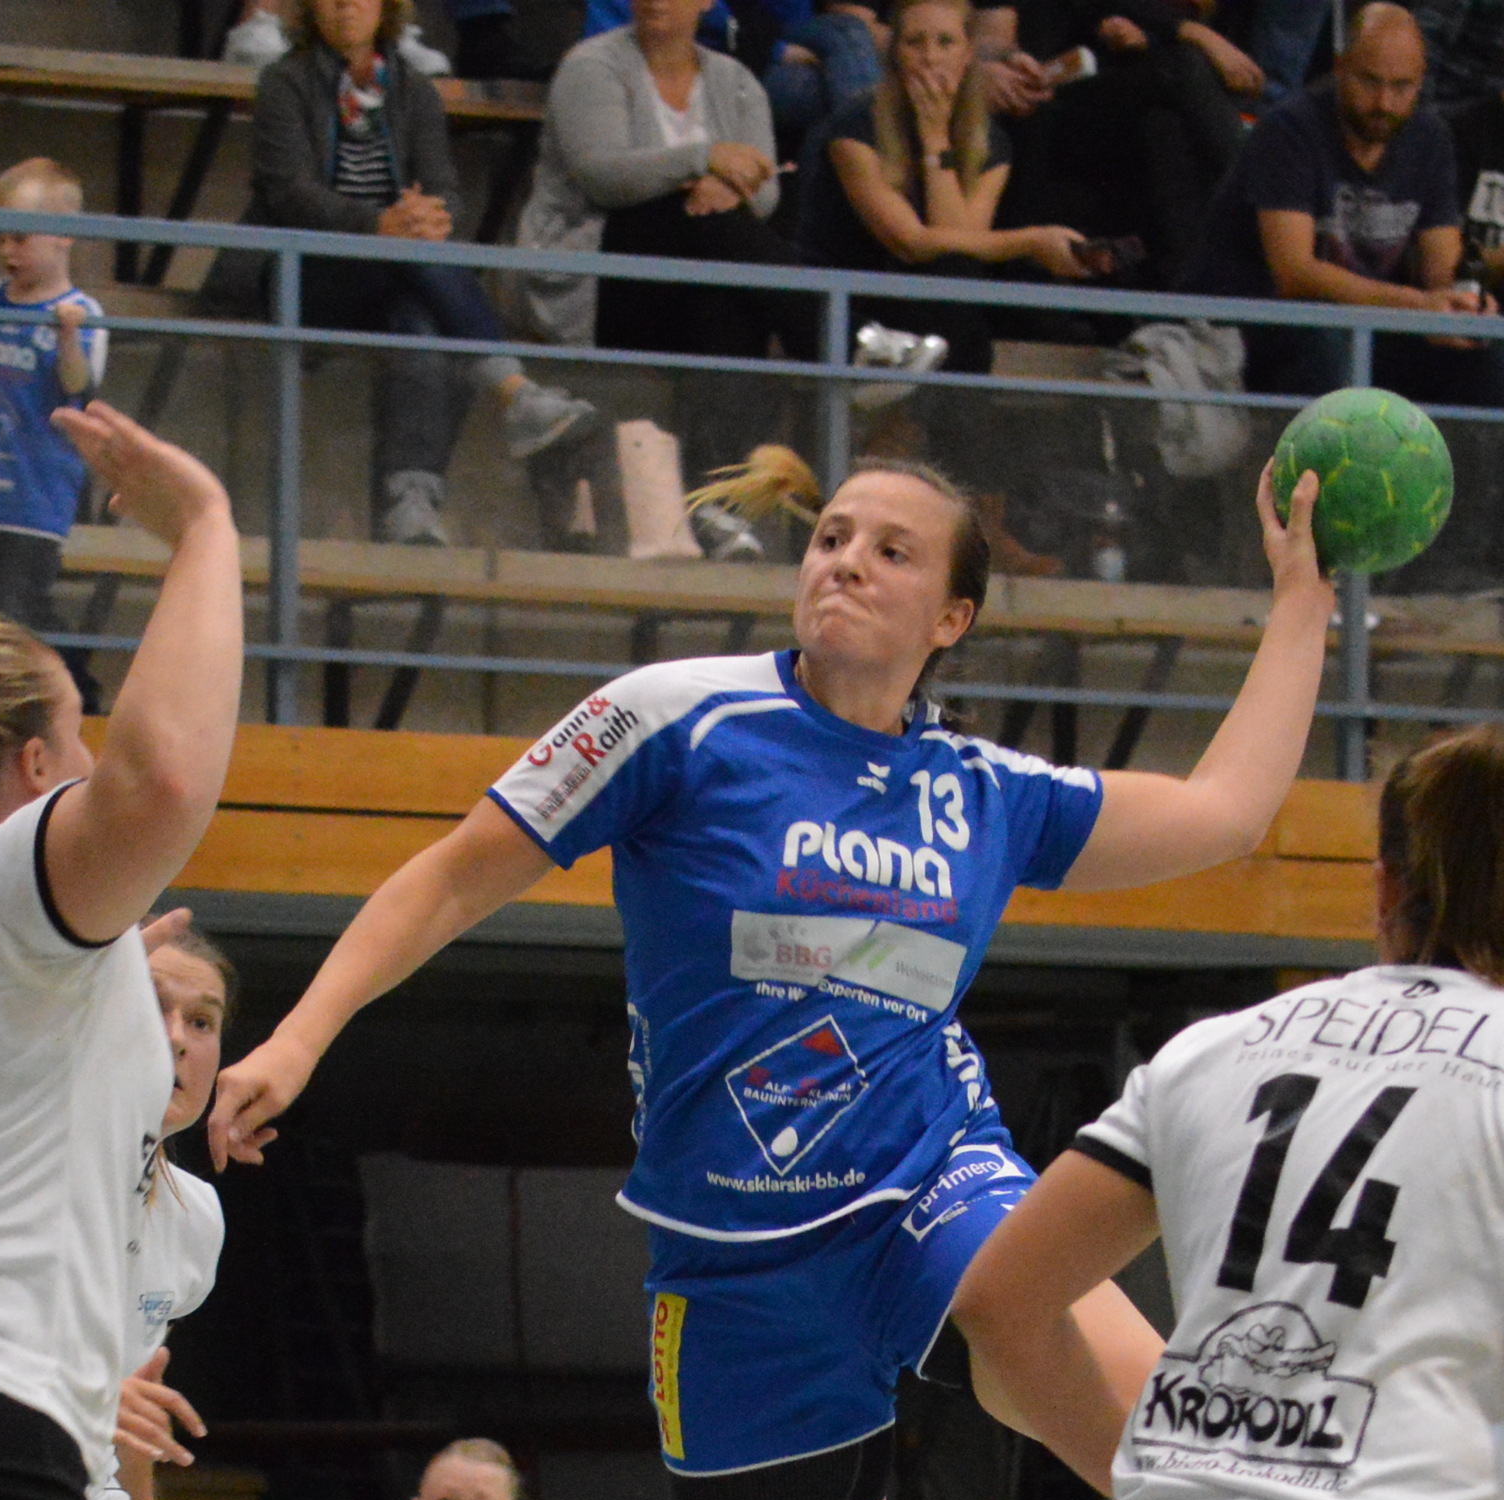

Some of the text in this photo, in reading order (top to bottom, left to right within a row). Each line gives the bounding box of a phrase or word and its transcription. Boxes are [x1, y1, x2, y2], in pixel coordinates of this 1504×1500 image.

[571, 706, 639, 767] Raith
[910, 769, 970, 851] 13
[776, 867, 958, 925] Küchenland
[775, 942, 832, 970] BBG
[755, 981, 786, 999] Ihre
[882, 997, 906, 1016] vor
[906, 1004, 928, 1024] Ort
[706, 1168, 866, 1193] www.sklarski-bb.de
[917, 1159, 1002, 1214] primero
[1216, 1073, 1419, 1309] 14
[1142, 1371, 1343, 1449] KROKODIL
